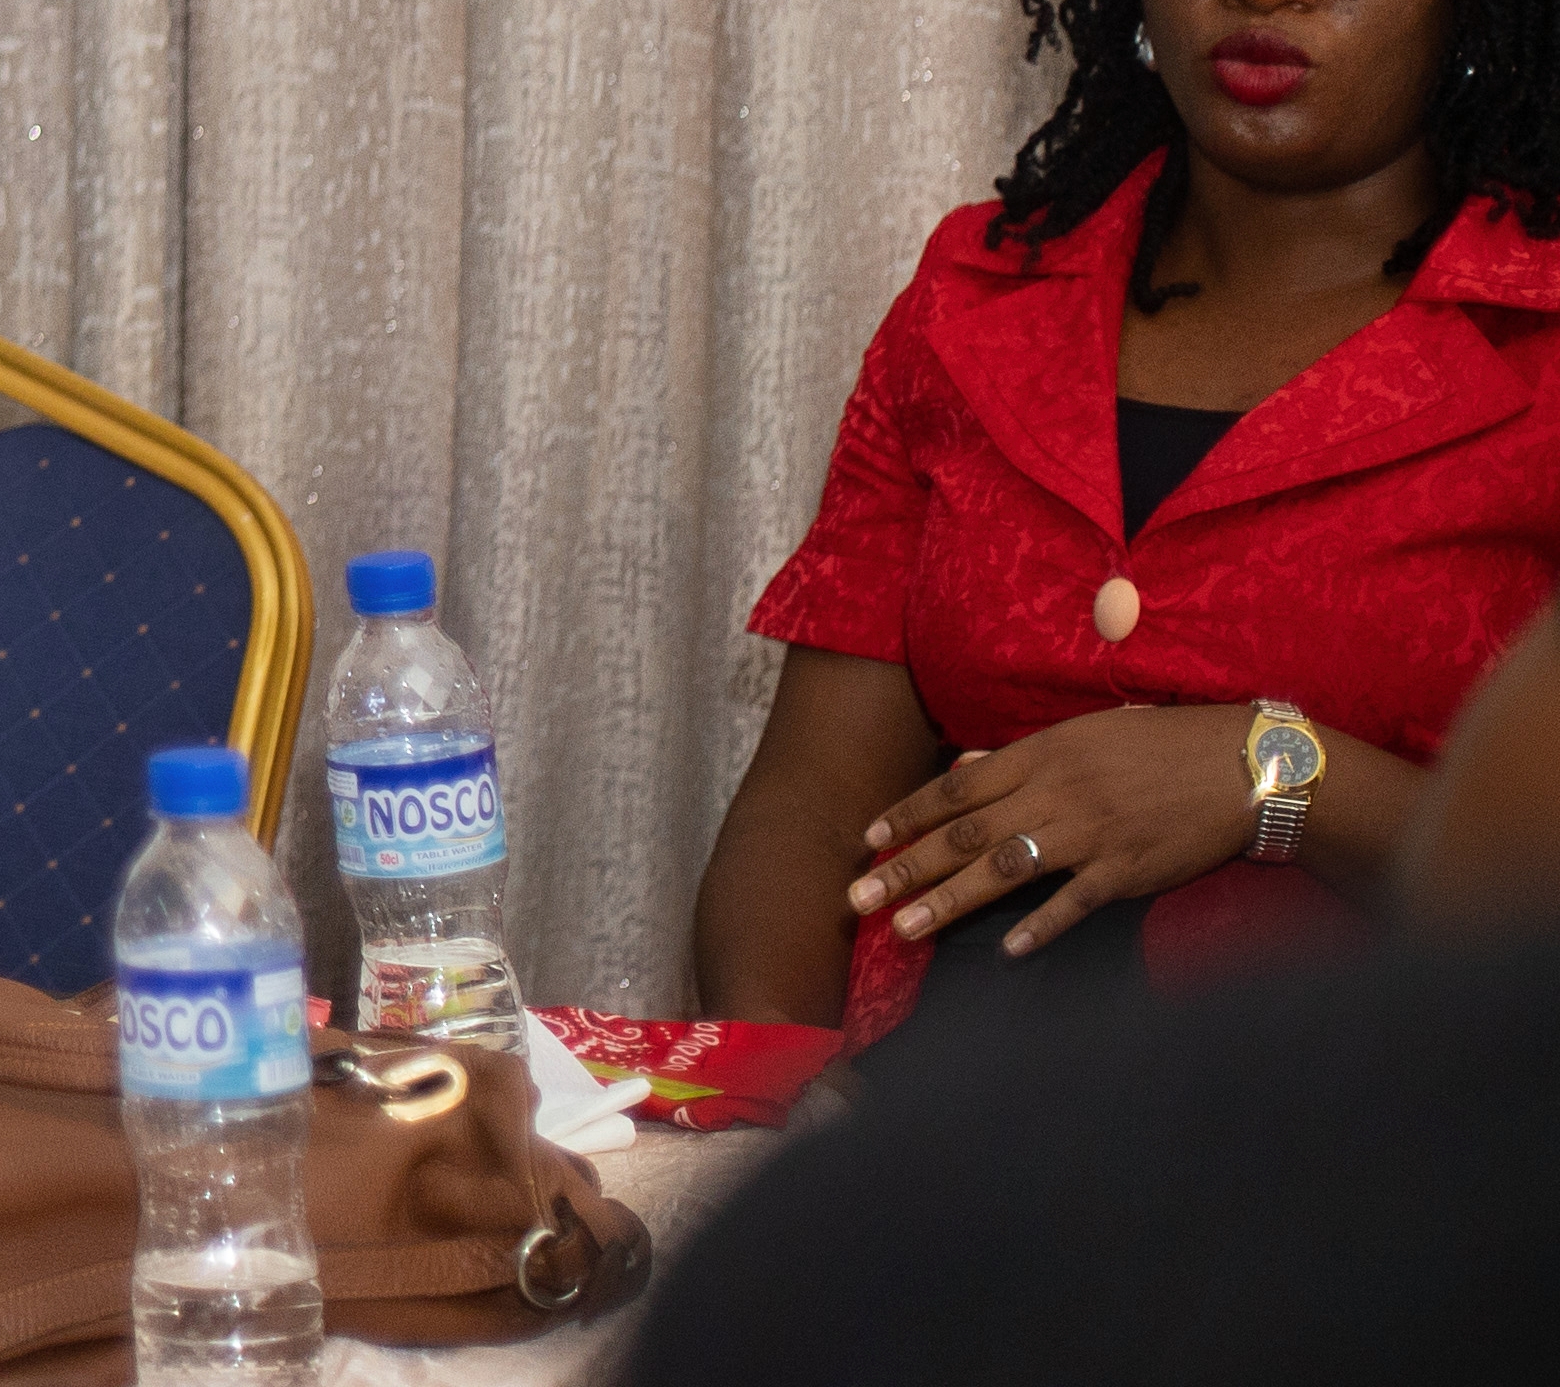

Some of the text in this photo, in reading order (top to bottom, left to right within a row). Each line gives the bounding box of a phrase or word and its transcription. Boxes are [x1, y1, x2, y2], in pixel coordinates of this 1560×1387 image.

[369, 780, 496, 838] NOSCO
[380, 853, 399, 865] 50cl
[416, 850, 449, 860] TABLE
[451, 842, 483, 856] WATER
[121, 998, 229, 1053] OSCO
